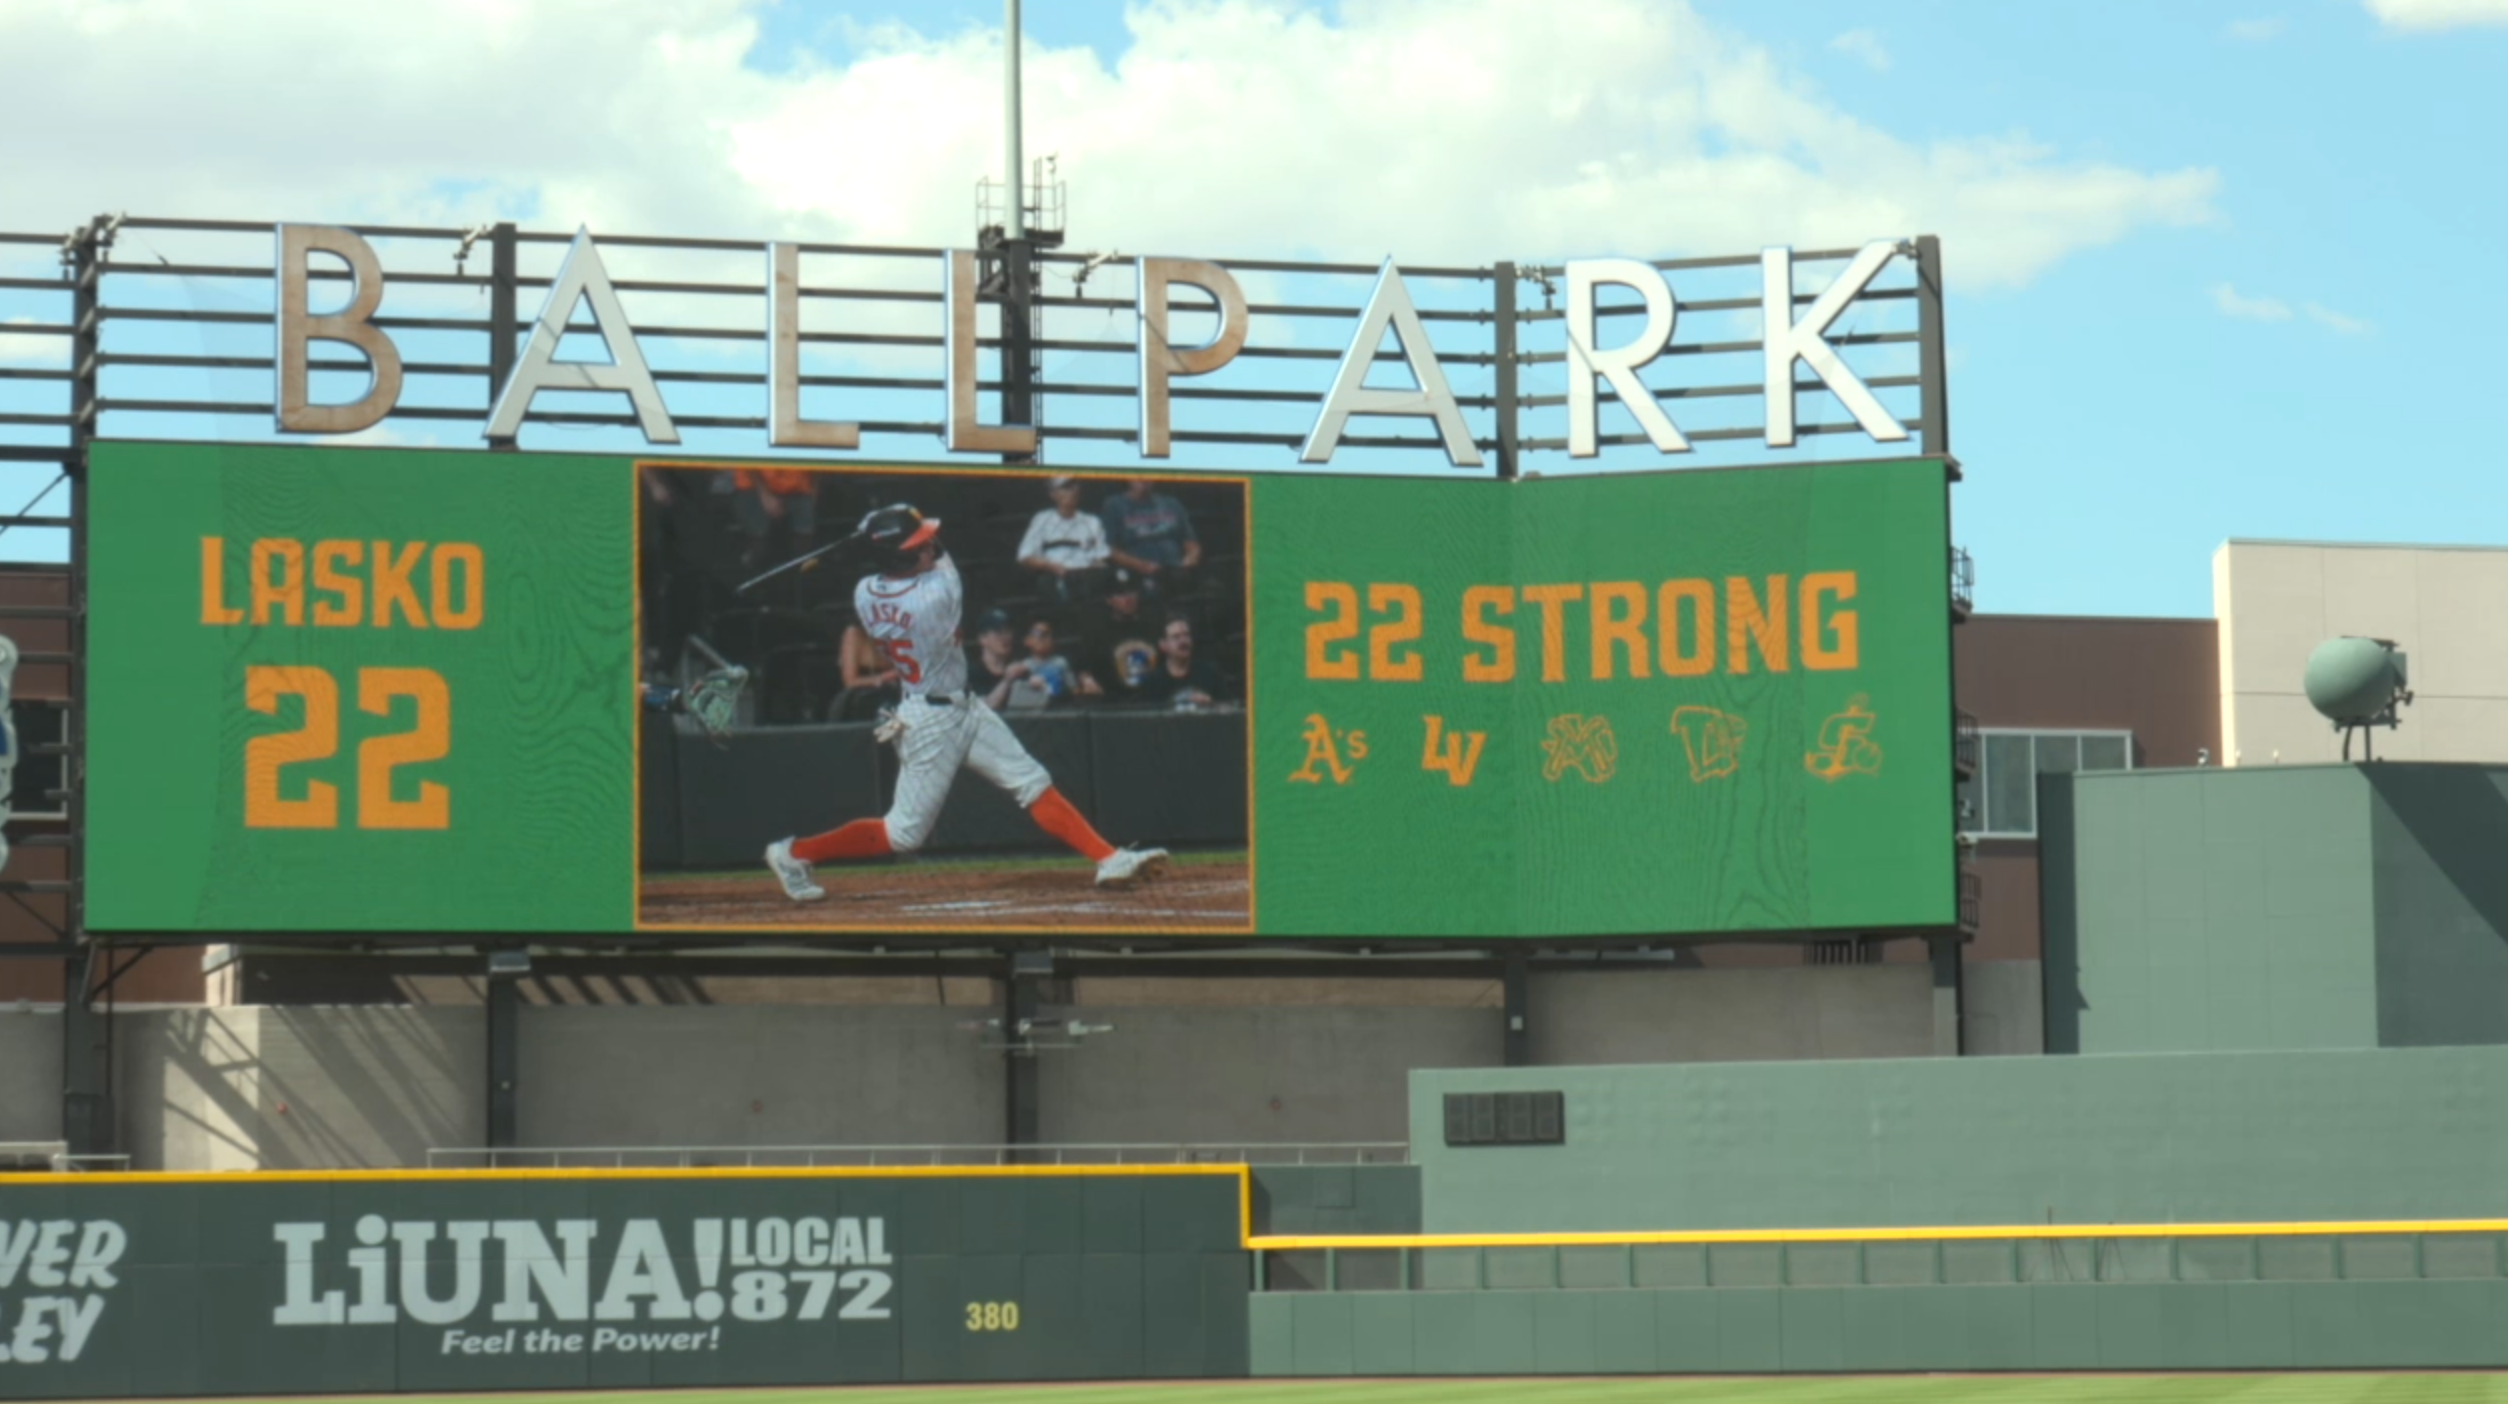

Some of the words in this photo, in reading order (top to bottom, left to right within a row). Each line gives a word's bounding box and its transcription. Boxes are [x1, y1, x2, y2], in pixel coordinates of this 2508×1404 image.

[274, 222, 1912, 467] BALLPARK
[200, 536, 484, 630] LASKO
[1304, 580, 1424, 682] 22
[1461, 570, 1859, 684] STRONG
[244, 664, 452, 831] 22
[1421, 714, 1487, 787] LV
[272, 1214, 725, 1326] LiUNA!
[730, 1216, 893, 1267] LOCAL
[730, 1269, 893, 1321] 872
[965, 1301, 1020, 1332] 380
[441, 1329, 516, 1355] Feel
[523, 1328, 585, 1354] the
[592, 1326, 721, 1352] Power!
